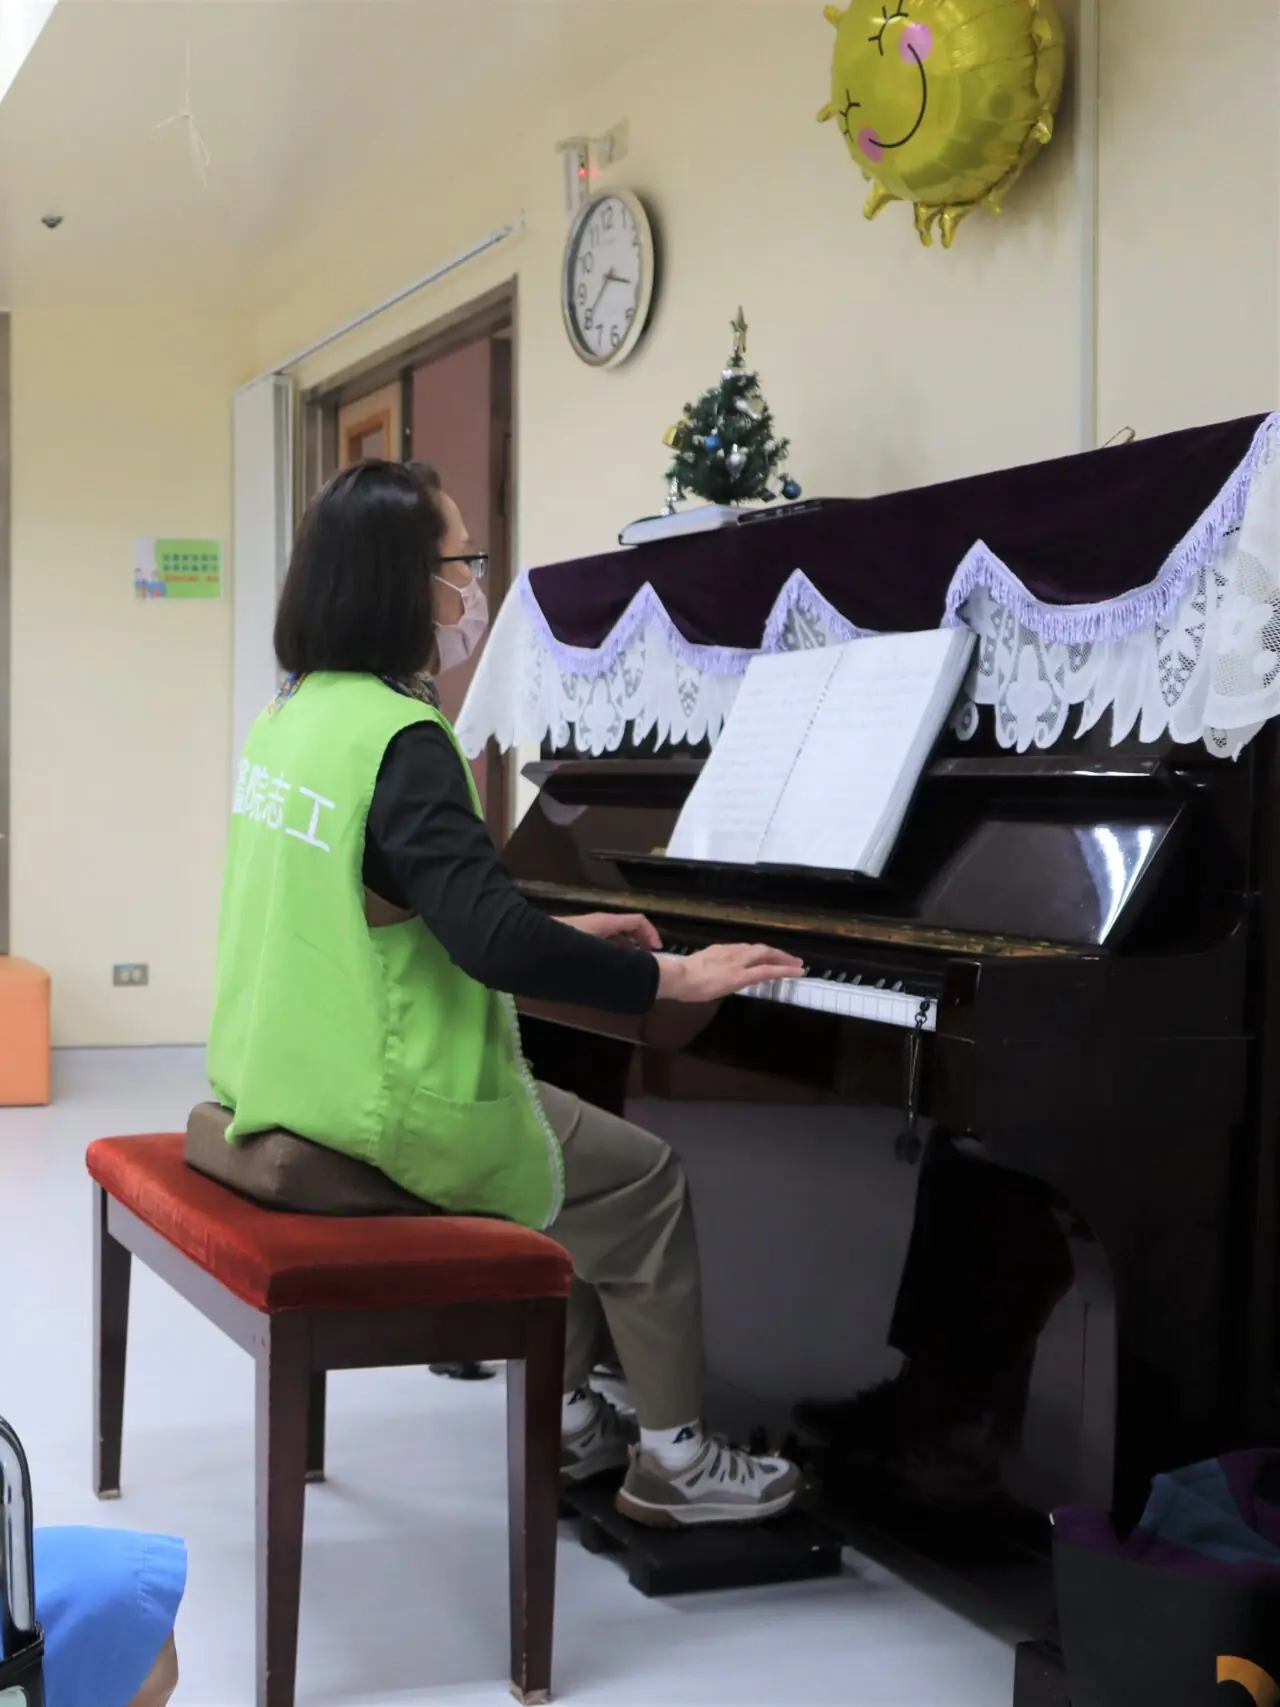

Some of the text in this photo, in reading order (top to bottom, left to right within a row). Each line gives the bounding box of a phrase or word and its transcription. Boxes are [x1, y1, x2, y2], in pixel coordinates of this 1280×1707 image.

[600, 204, 615, 233] 12
[588, 223, 600, 250] 11
[579, 250, 594, 277] 10
[577, 282, 587, 307] 9
[584, 307, 594, 331] 8
[594, 322, 604, 349] 7
[609, 323, 621, 348] 6
